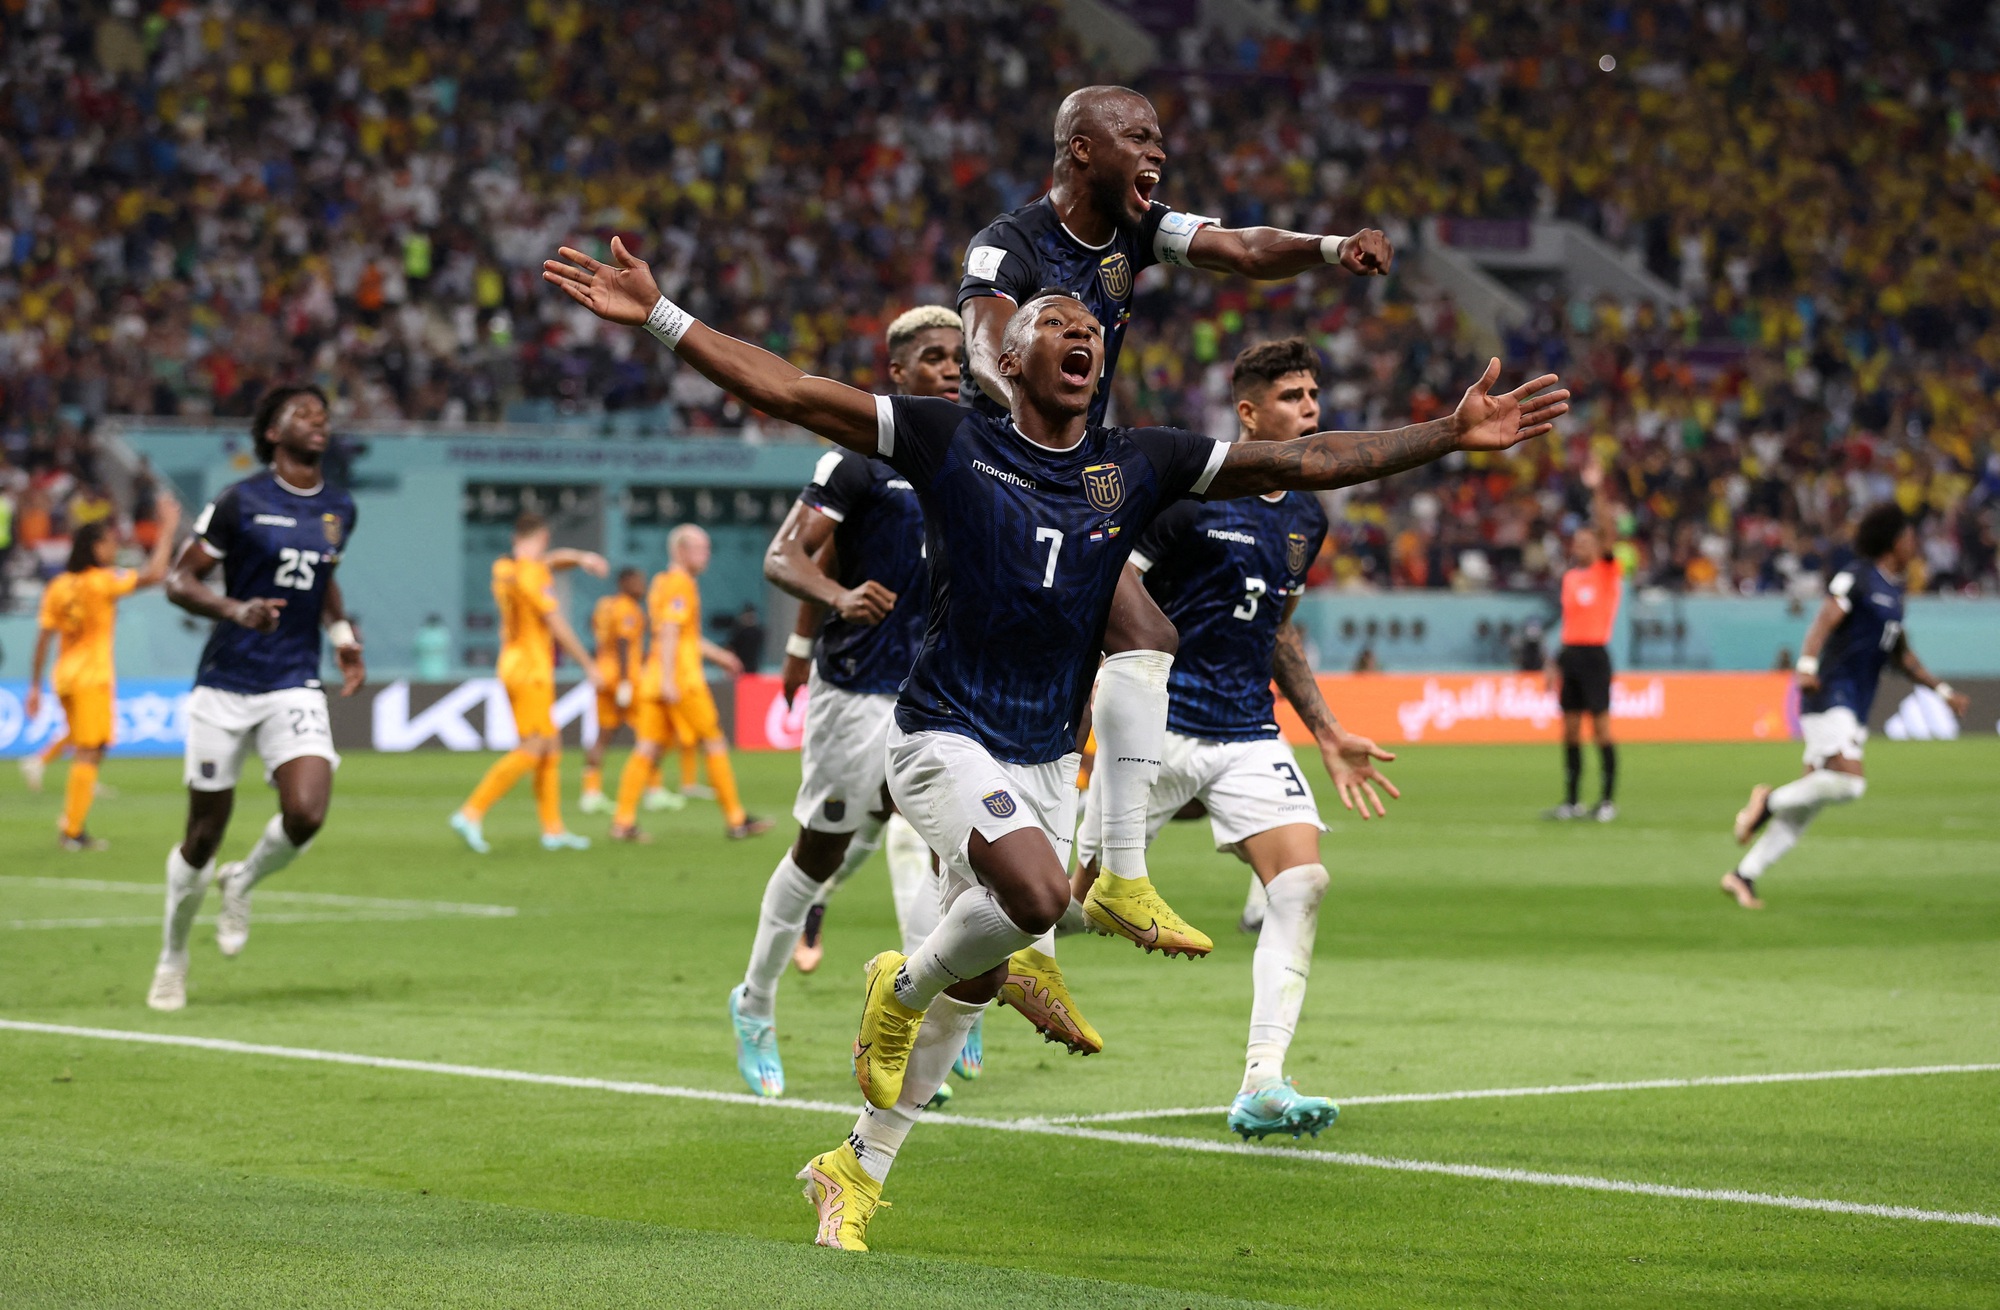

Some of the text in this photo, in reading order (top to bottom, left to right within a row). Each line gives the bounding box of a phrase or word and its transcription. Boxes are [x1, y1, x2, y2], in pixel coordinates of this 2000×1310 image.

[972, 459, 1037, 490] marathon
[1207, 528, 1255, 545] marathon
[273, 547, 321, 591] 25
[1035, 526, 1065, 588] 7
[1233, 577, 1267, 621] 3
[1272, 762, 1306, 797] 3
